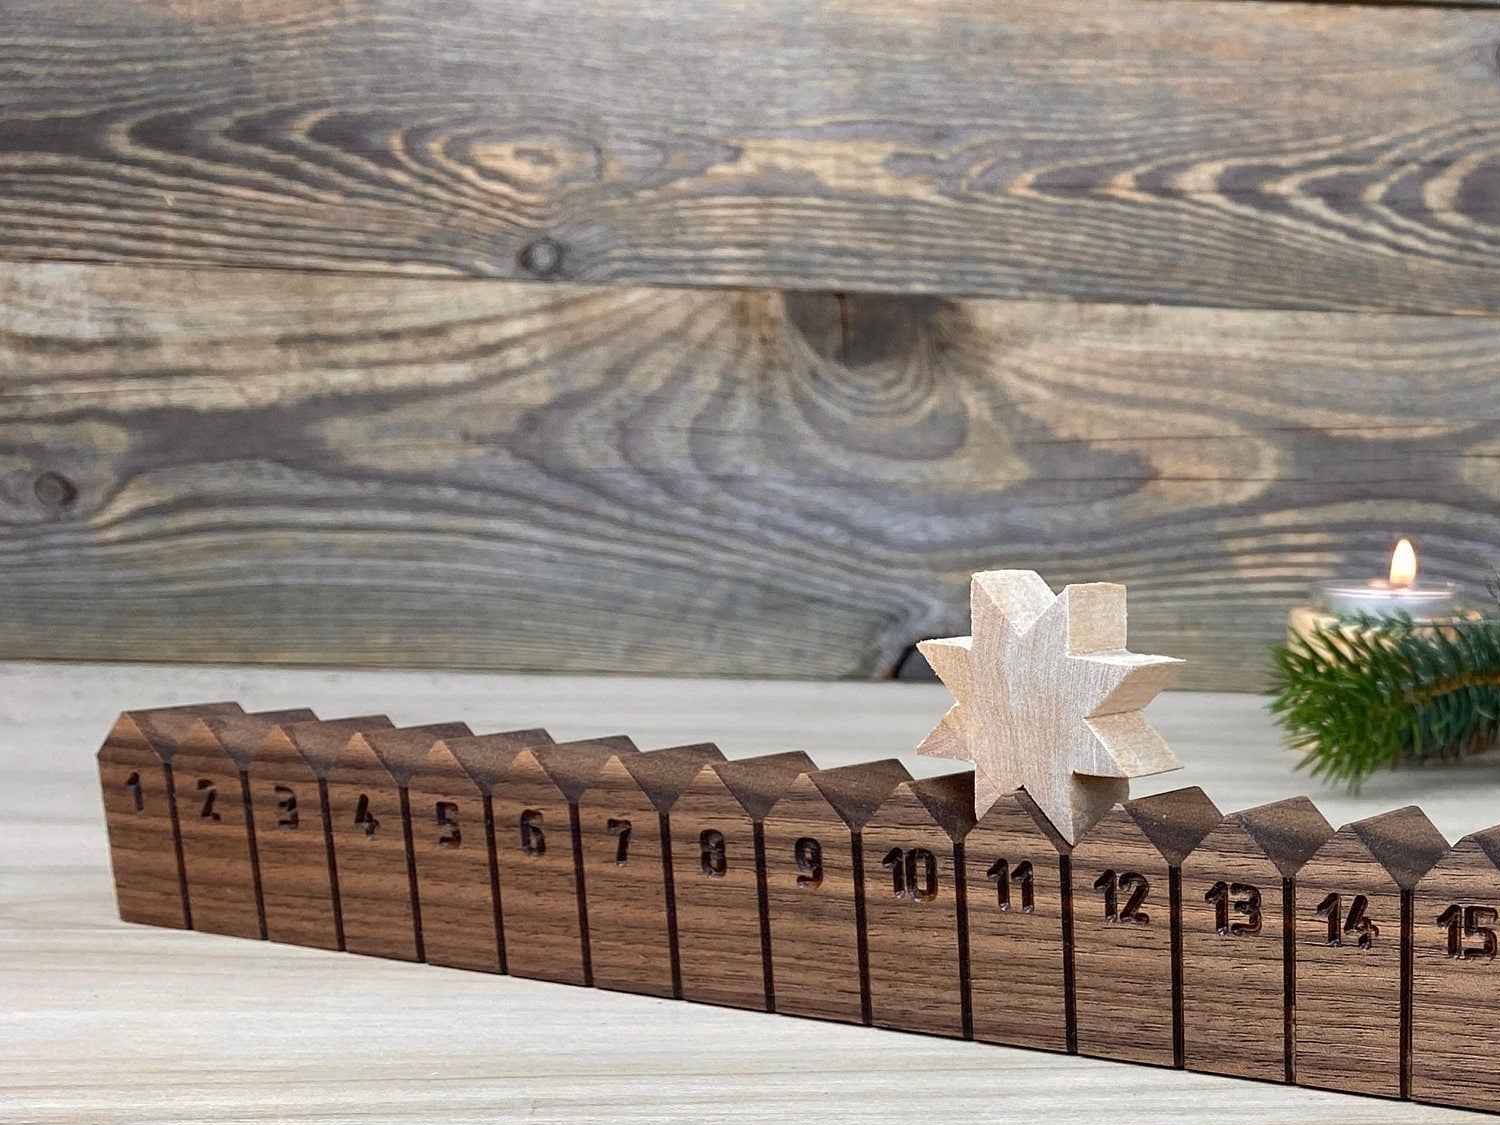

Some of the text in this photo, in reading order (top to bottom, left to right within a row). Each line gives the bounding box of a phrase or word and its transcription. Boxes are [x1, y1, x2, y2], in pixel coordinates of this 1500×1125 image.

[125, 771, 144, 812] 1
[196, 778, 221, 823] 2
[273, 785, 299, 831] 3
[354, 793, 380, 839] 4
[435, 800, 461, 849] 5
[519, 808, 547, 857] 6
[606, 818, 632, 868] 7
[699, 828, 727, 877] 8
[793, 837, 824, 889] 9
[881, 846, 938, 902] 10
[986, 857, 1035, 913] 11
[1093, 868, 1151, 925] 12
[1204, 880, 1263, 937] 13
[1316, 892, 1380, 950] 14
[1435, 903, 1498, 961] 15
